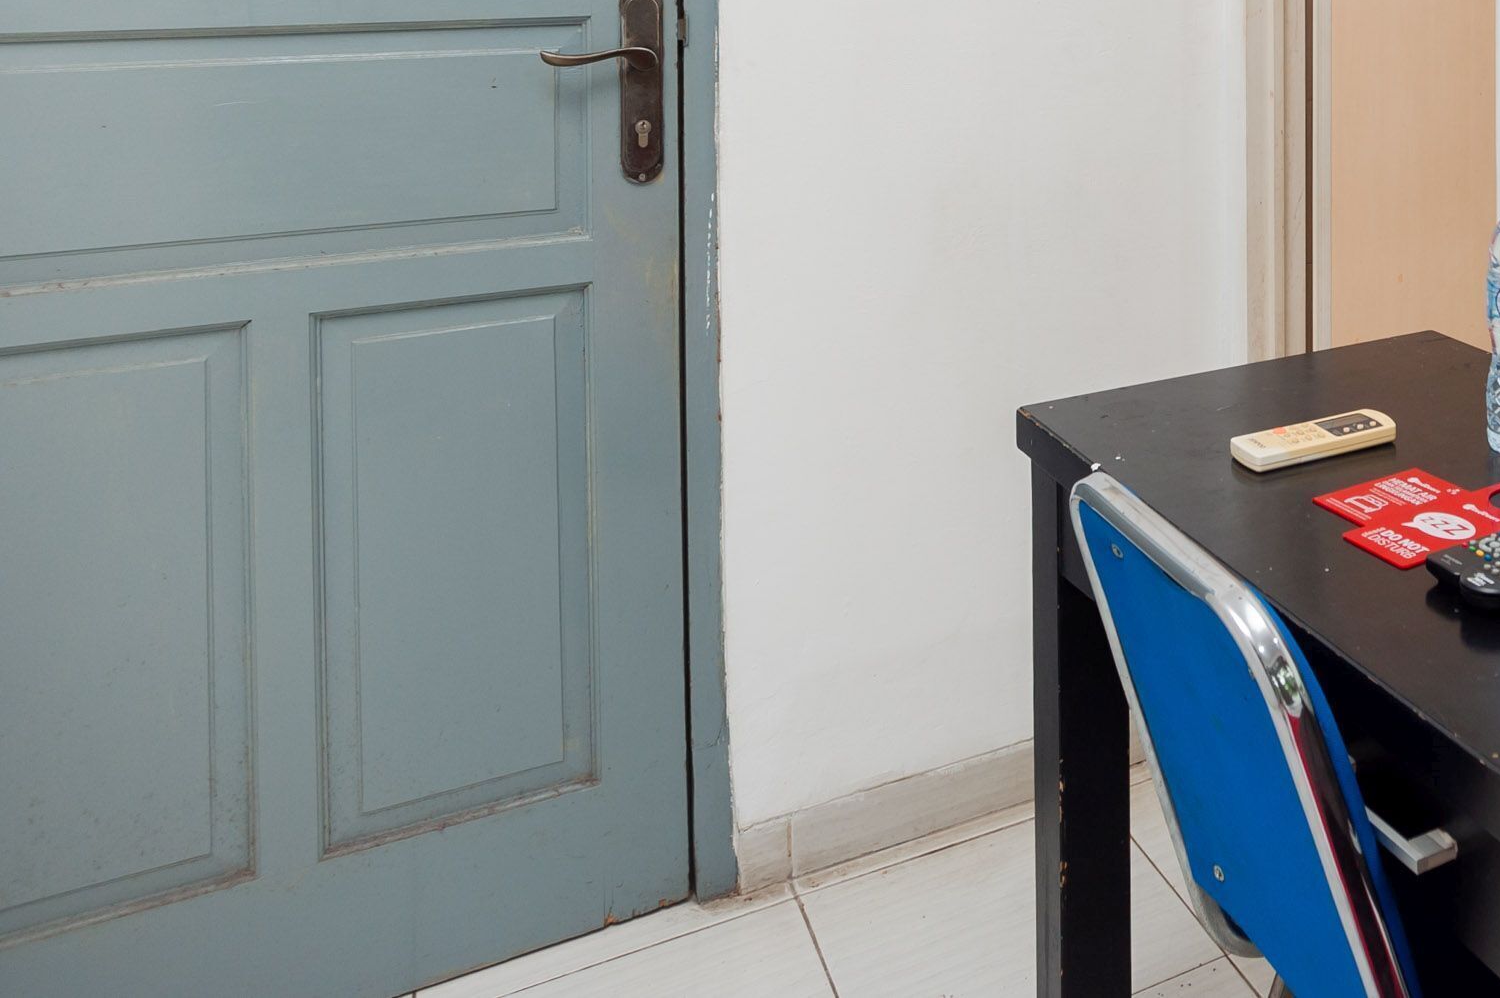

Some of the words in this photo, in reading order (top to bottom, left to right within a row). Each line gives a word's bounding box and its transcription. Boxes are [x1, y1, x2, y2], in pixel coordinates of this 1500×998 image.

[1367, 534, 1417, 560] DISTURB
[1380, 529, 1403, 541] DO
[1402, 538, 1431, 553] NOT
